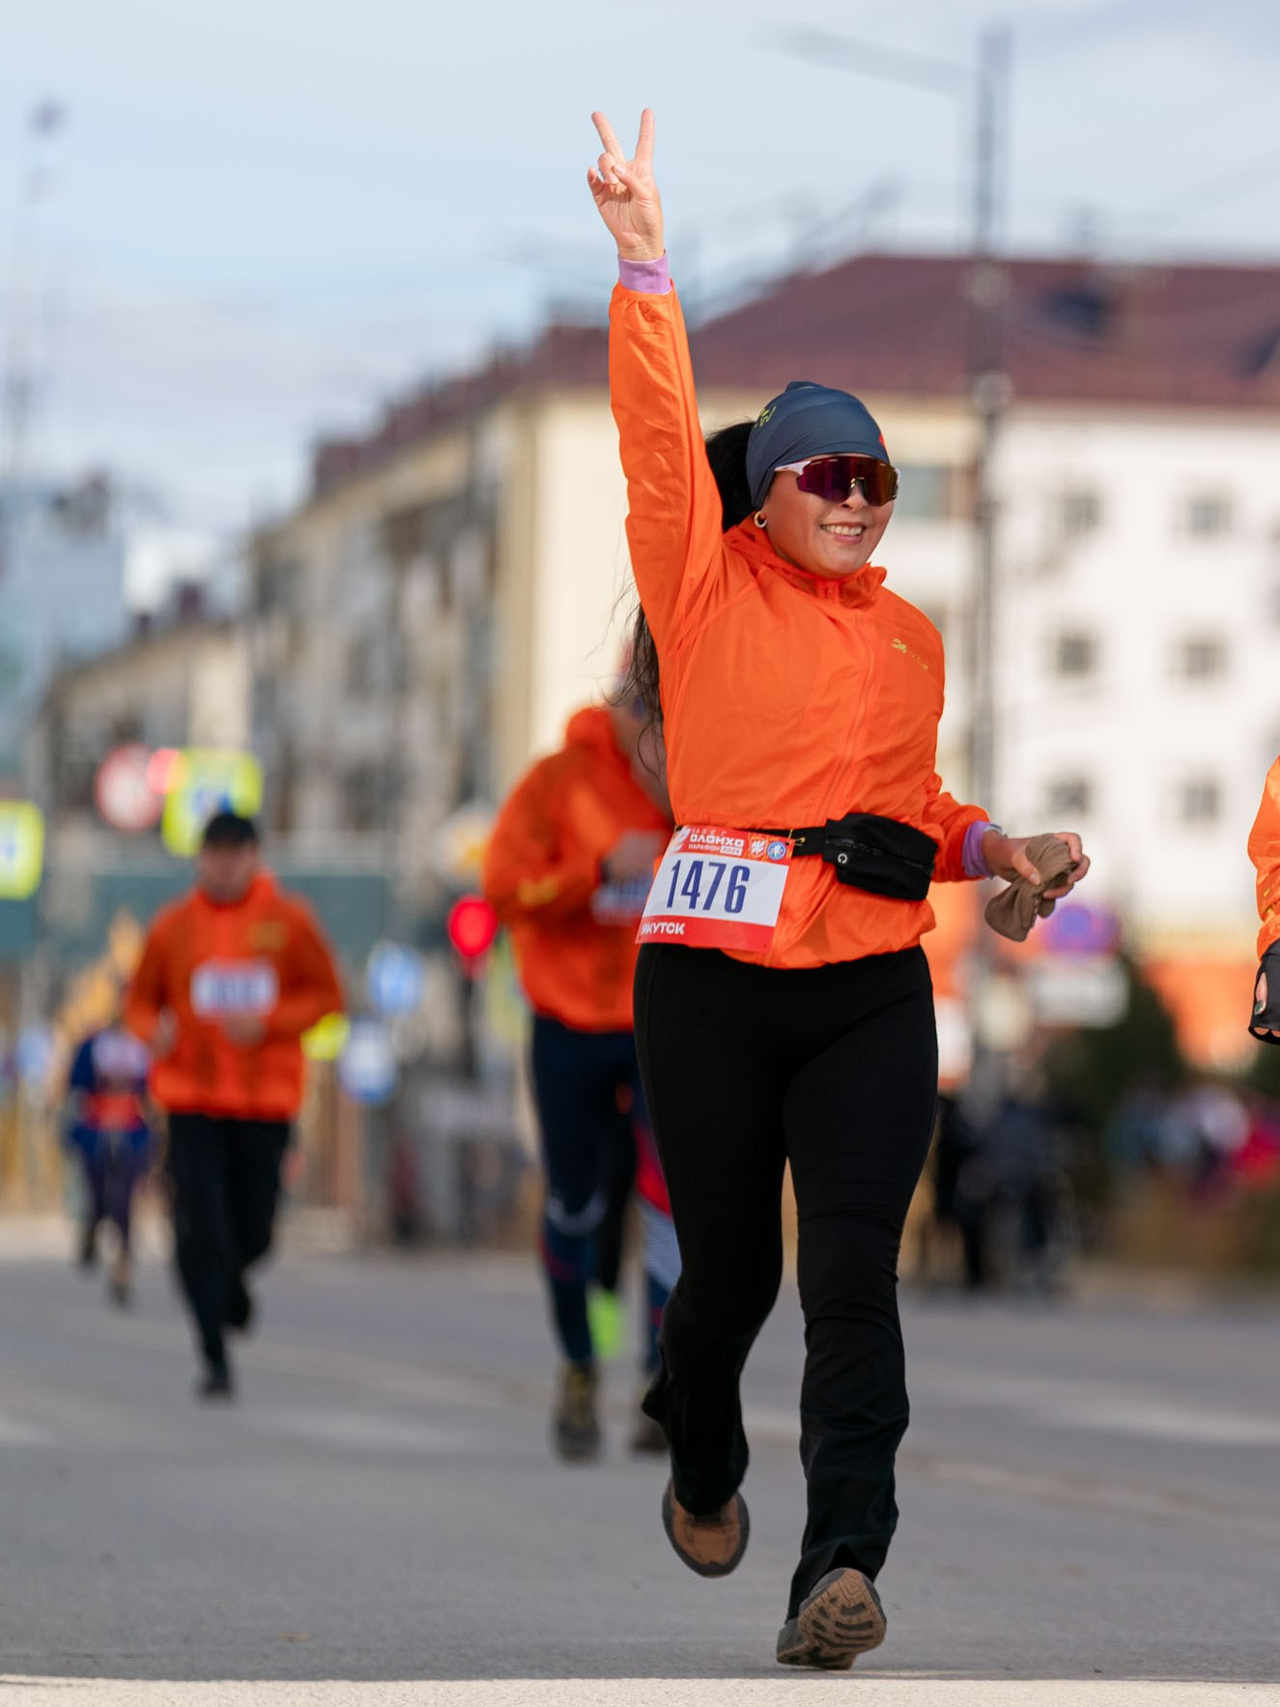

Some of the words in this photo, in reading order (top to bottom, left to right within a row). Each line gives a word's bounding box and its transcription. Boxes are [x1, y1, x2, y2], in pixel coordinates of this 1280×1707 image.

[689, 834, 744, 847] ОЛОНХО
[666, 859, 751, 914] 1476
[640, 922, 685, 935] ЯКУТСК
